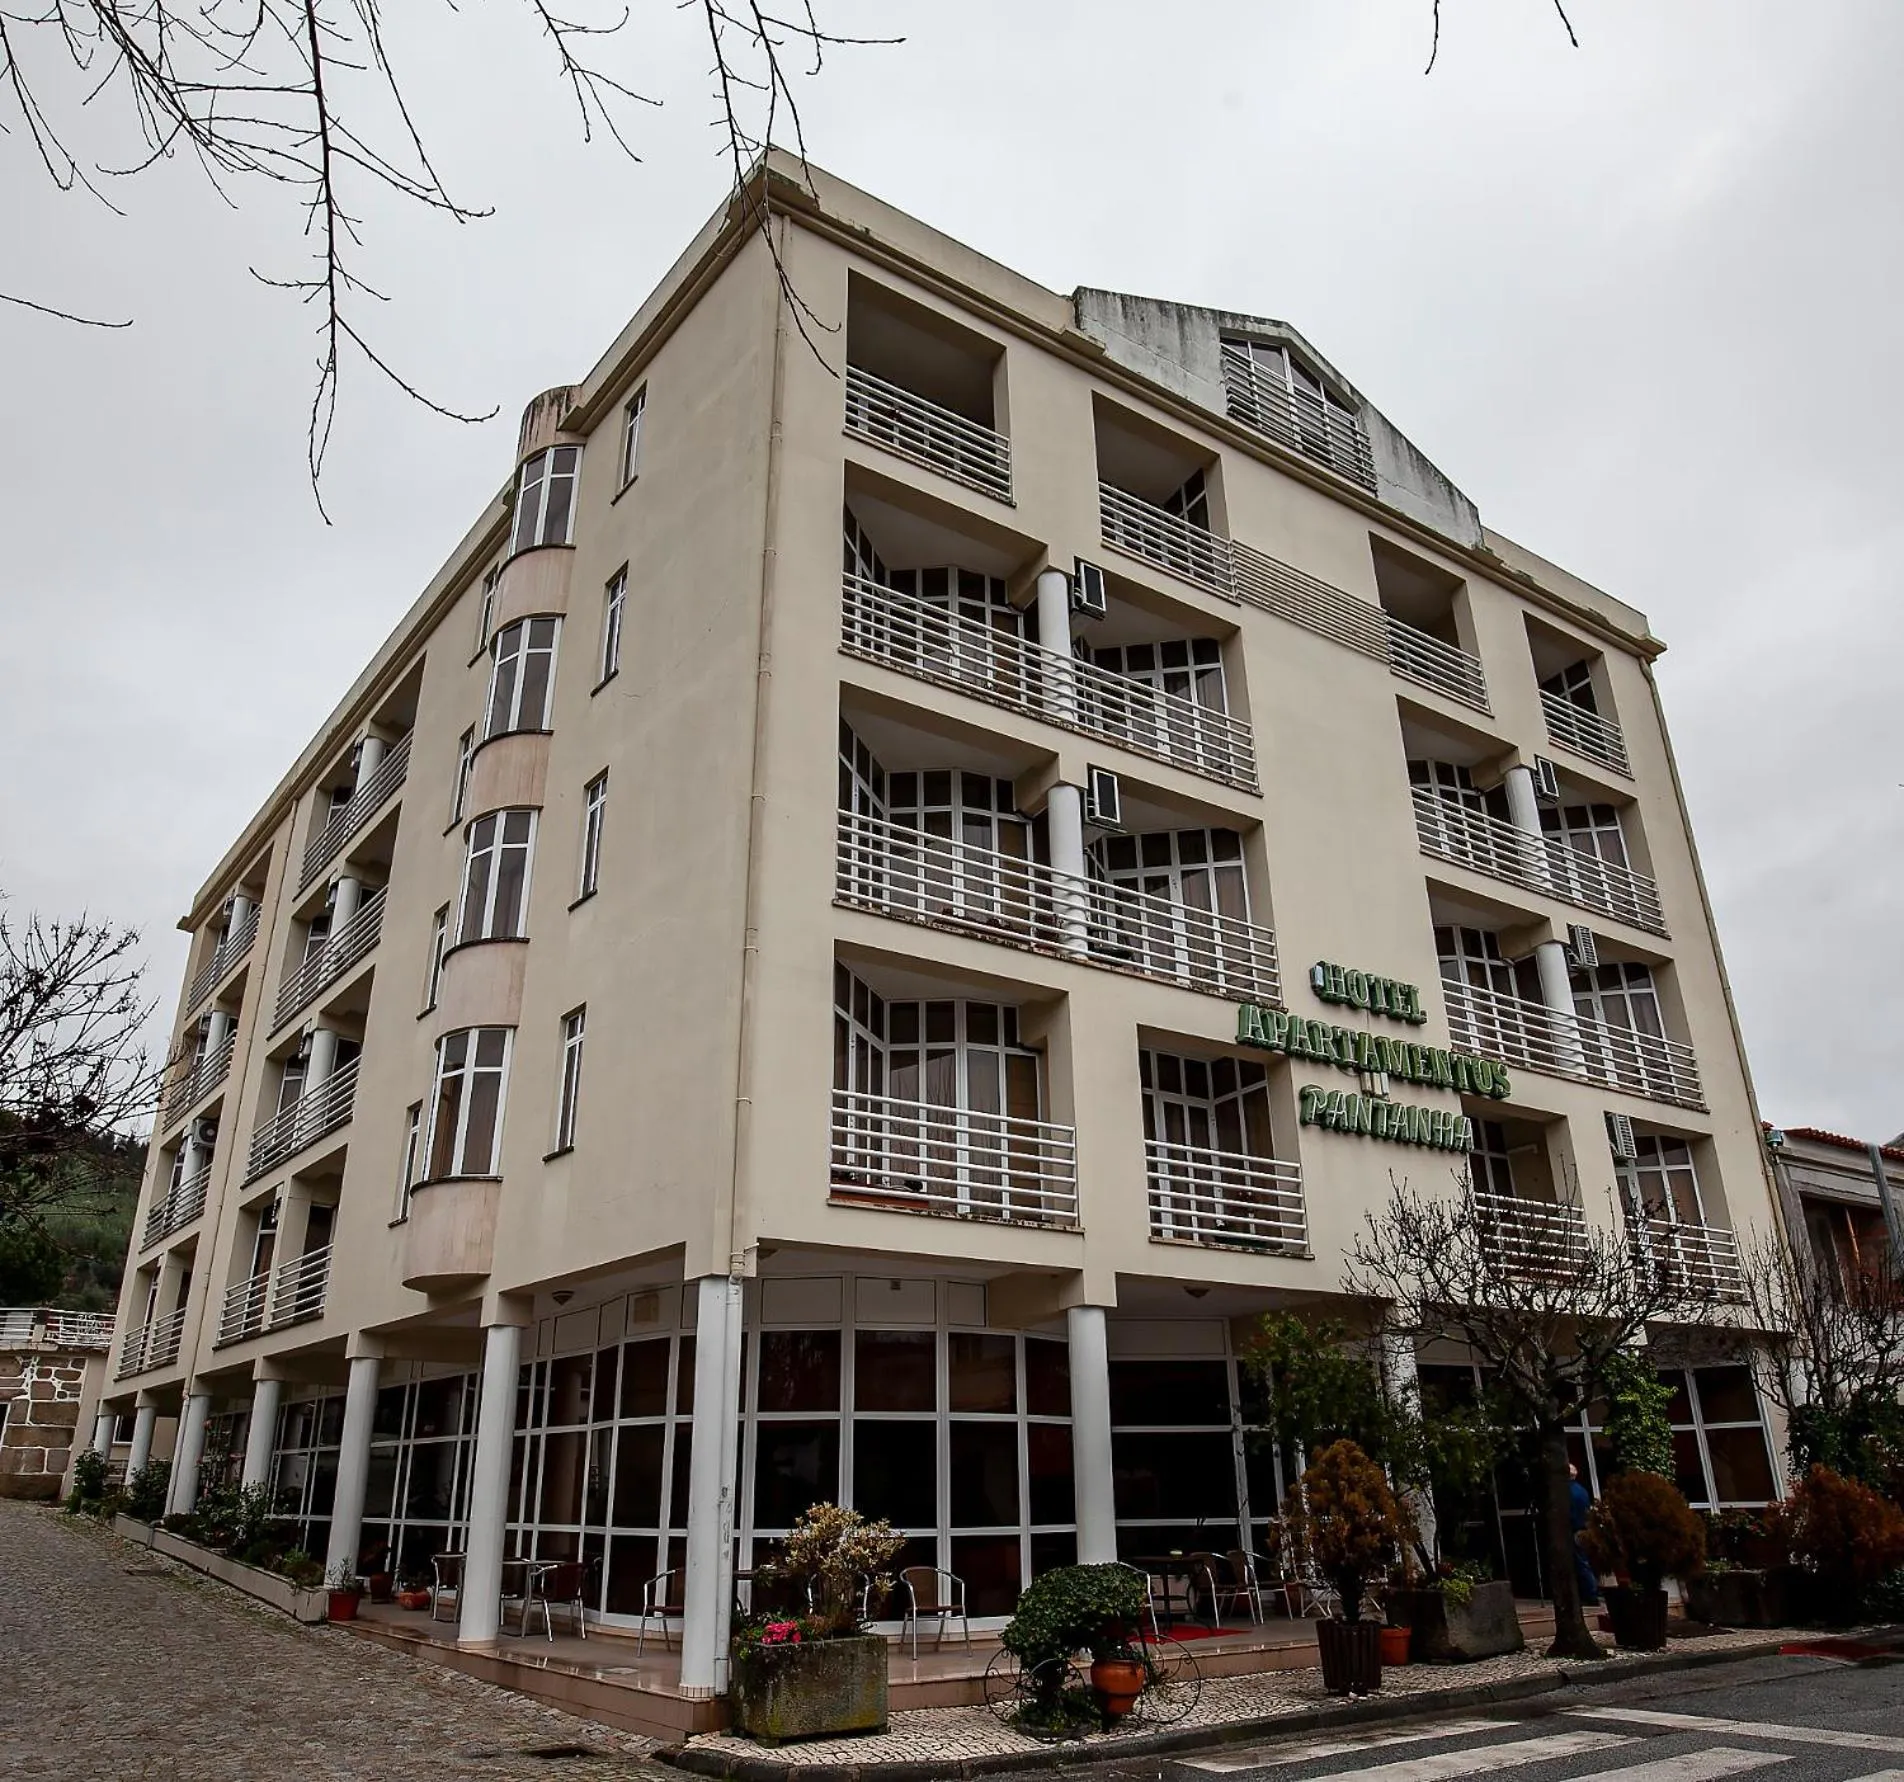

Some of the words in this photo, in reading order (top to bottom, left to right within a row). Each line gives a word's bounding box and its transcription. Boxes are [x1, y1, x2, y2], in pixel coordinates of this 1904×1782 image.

[1312, 961, 1427, 1024] HOTEL
[1237, 1003, 1512, 1098] APARTAMENTOS
[1300, 1084, 1474, 1152] PANTANHA
